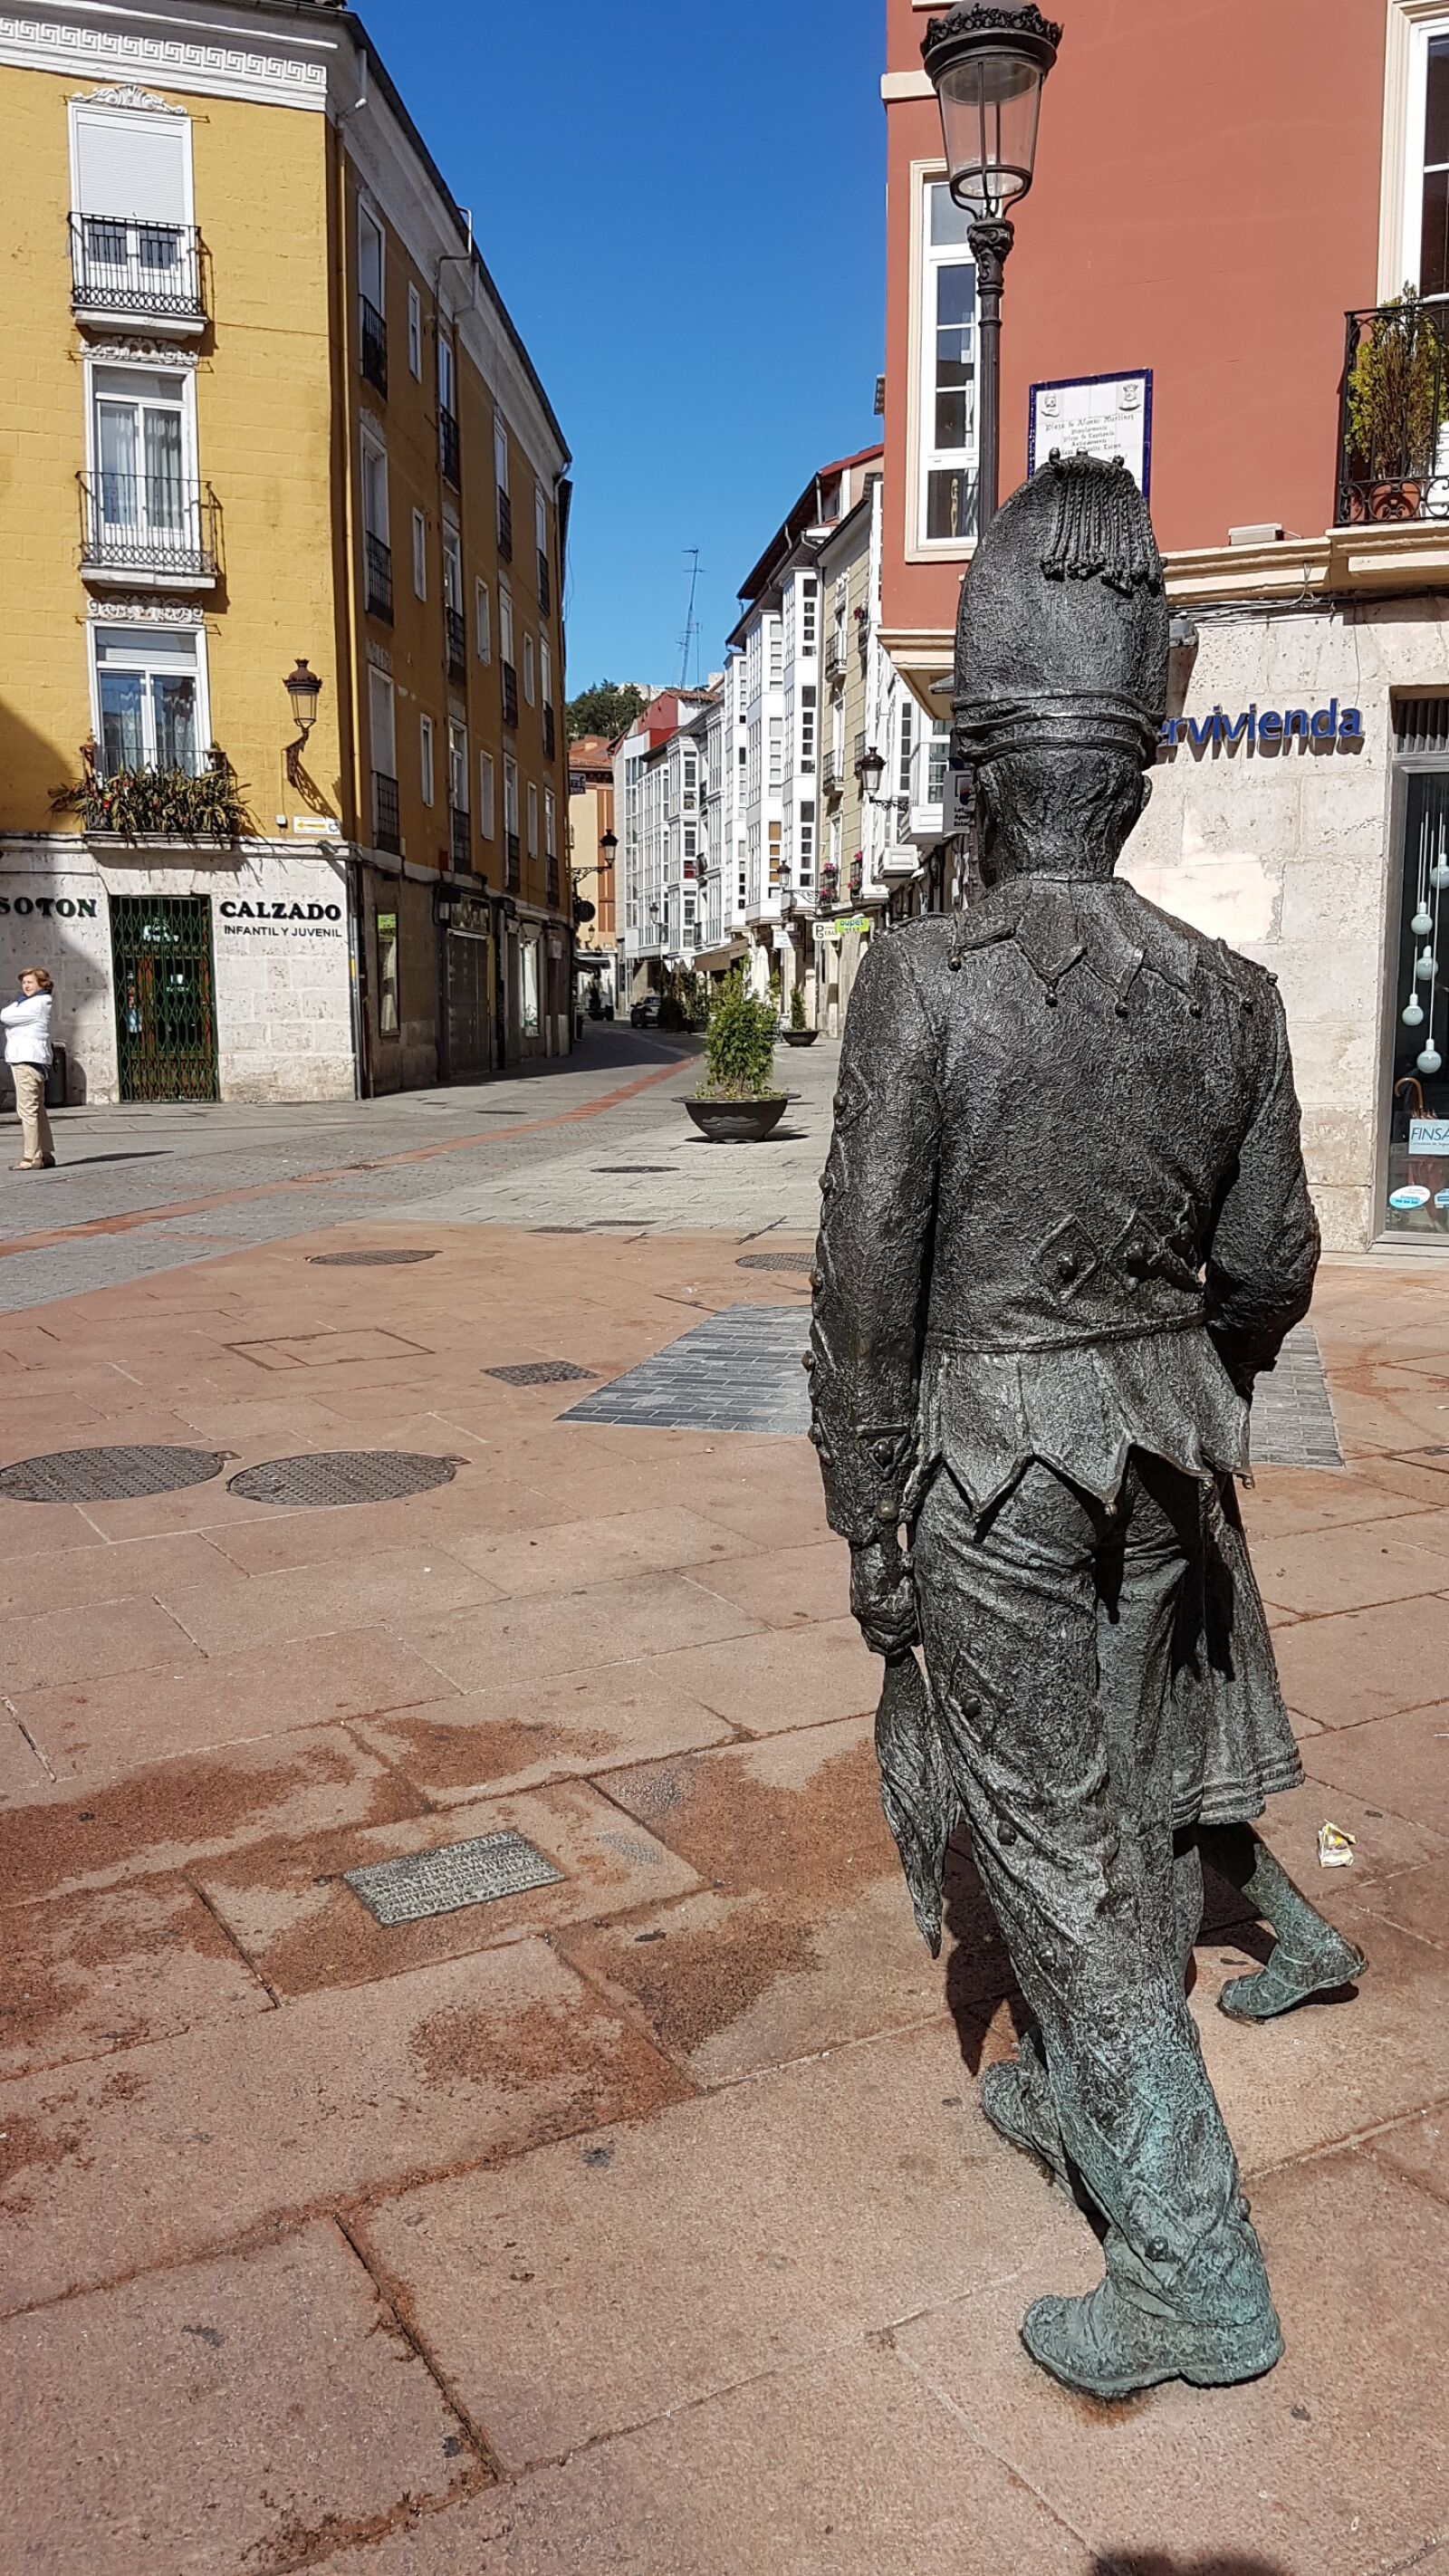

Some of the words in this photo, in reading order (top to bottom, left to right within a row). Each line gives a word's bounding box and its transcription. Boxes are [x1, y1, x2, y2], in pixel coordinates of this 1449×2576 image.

[220, 901, 341, 920] CALZADO
[225, 925, 279, 936] INFANTIL
[281, 928, 289, 936] Y
[292, 928, 342, 937] JUVENIL
